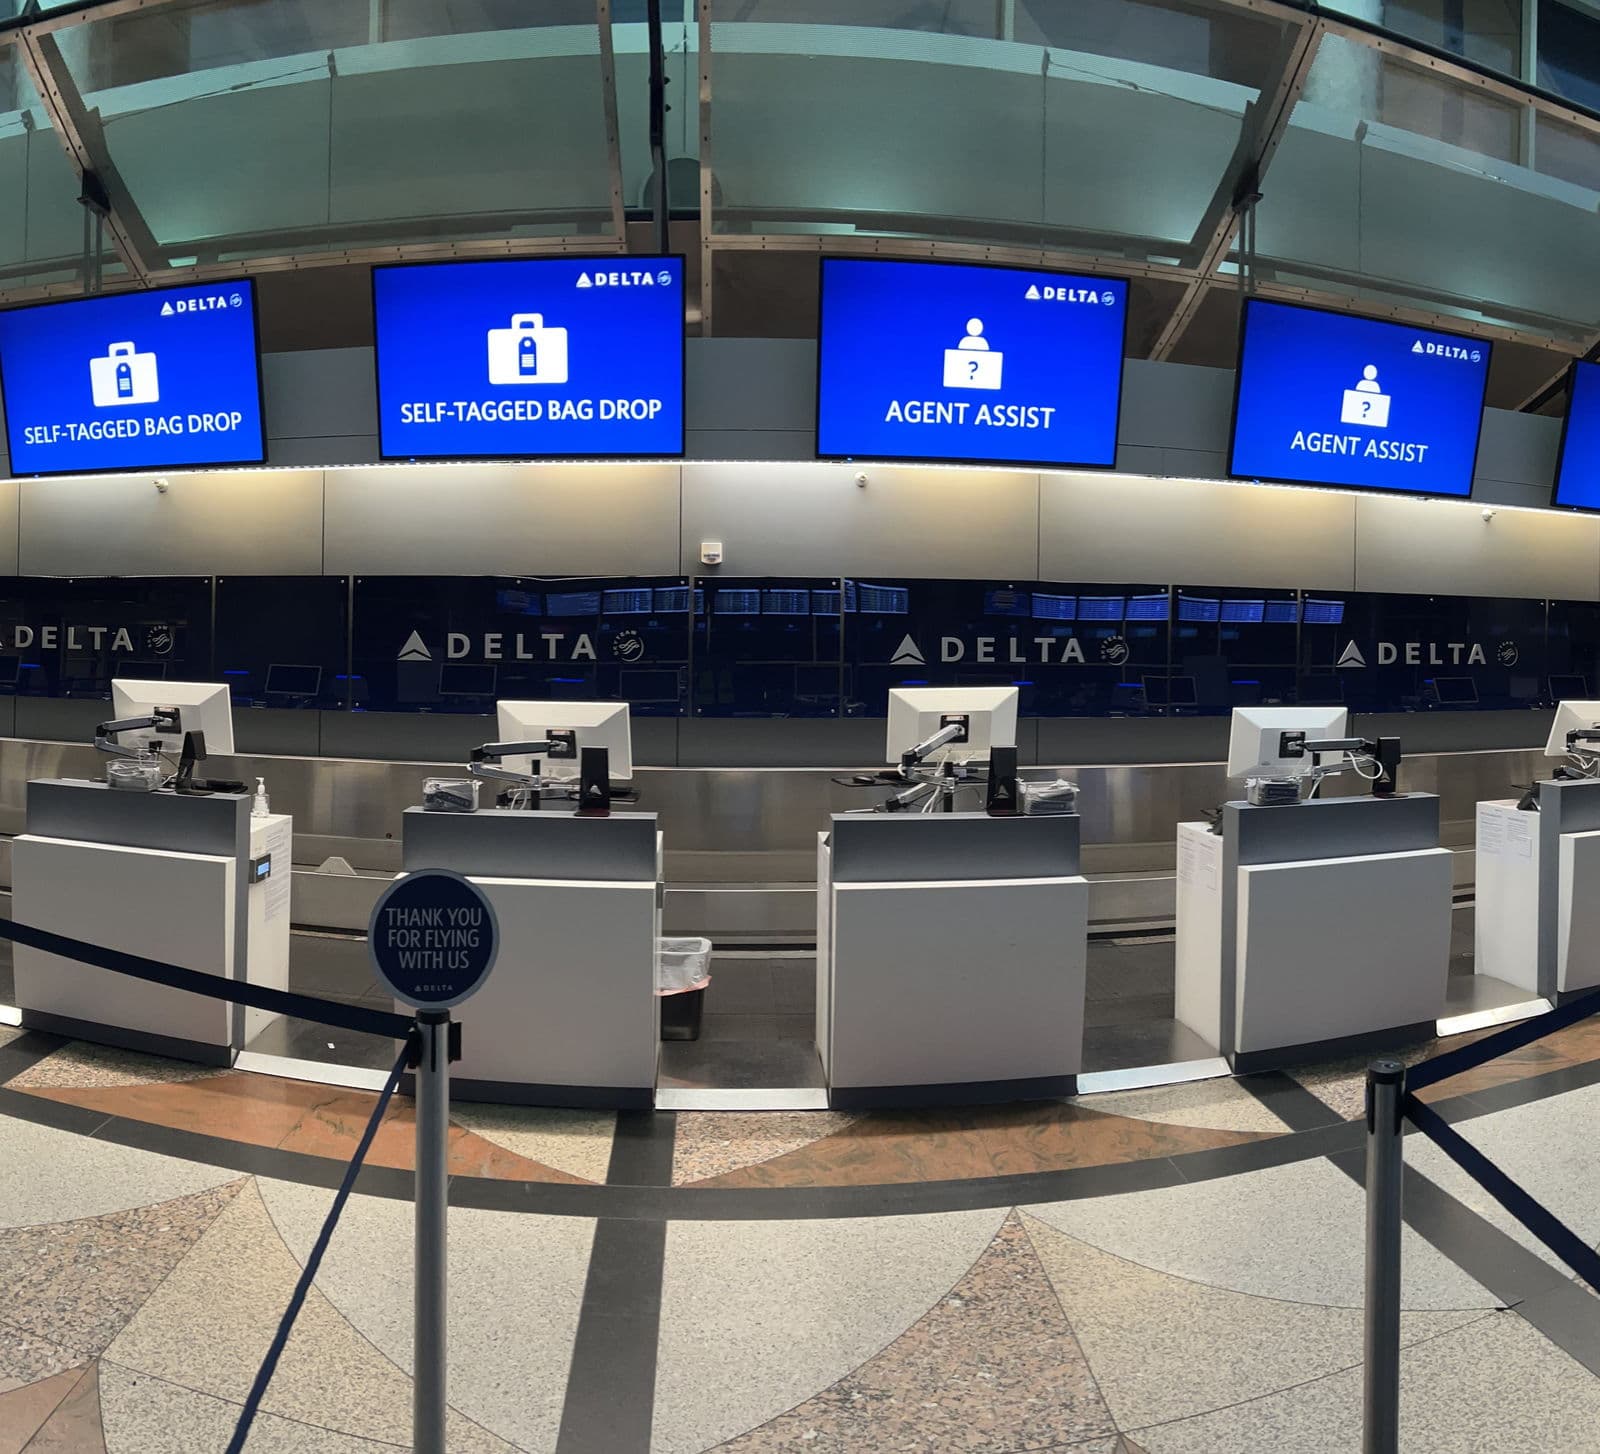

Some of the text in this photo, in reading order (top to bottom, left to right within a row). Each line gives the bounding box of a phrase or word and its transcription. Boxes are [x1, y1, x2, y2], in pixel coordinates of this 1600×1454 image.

[594, 271, 654, 288] DELTA
[176, 296, 227, 314] DELTA
[1043, 286, 1099, 304] DELTA
[1426, 342, 1468, 361] DELTA
[400, 398, 662, 424] SELF-TAGGED BAG DROP
[885, 400, 1056, 429] AGENT ASSIST
[24, 411, 242, 445] SELF-TAGGED BAG DROP
[1290, 430, 1429, 465] AGENT ASSIST
[14, 625, 134, 652] DELTA
[447, 632, 597, 661] DELTA
[941, 635, 1086, 664] DELTA
[1378, 641, 1487, 666] DELTA
[385, 907, 482, 927] THANK YOU
[388, 928, 480, 948] FOR FLYING
[398, 950, 470, 969] WITH US
[423, 984, 453, 992] DELTA
